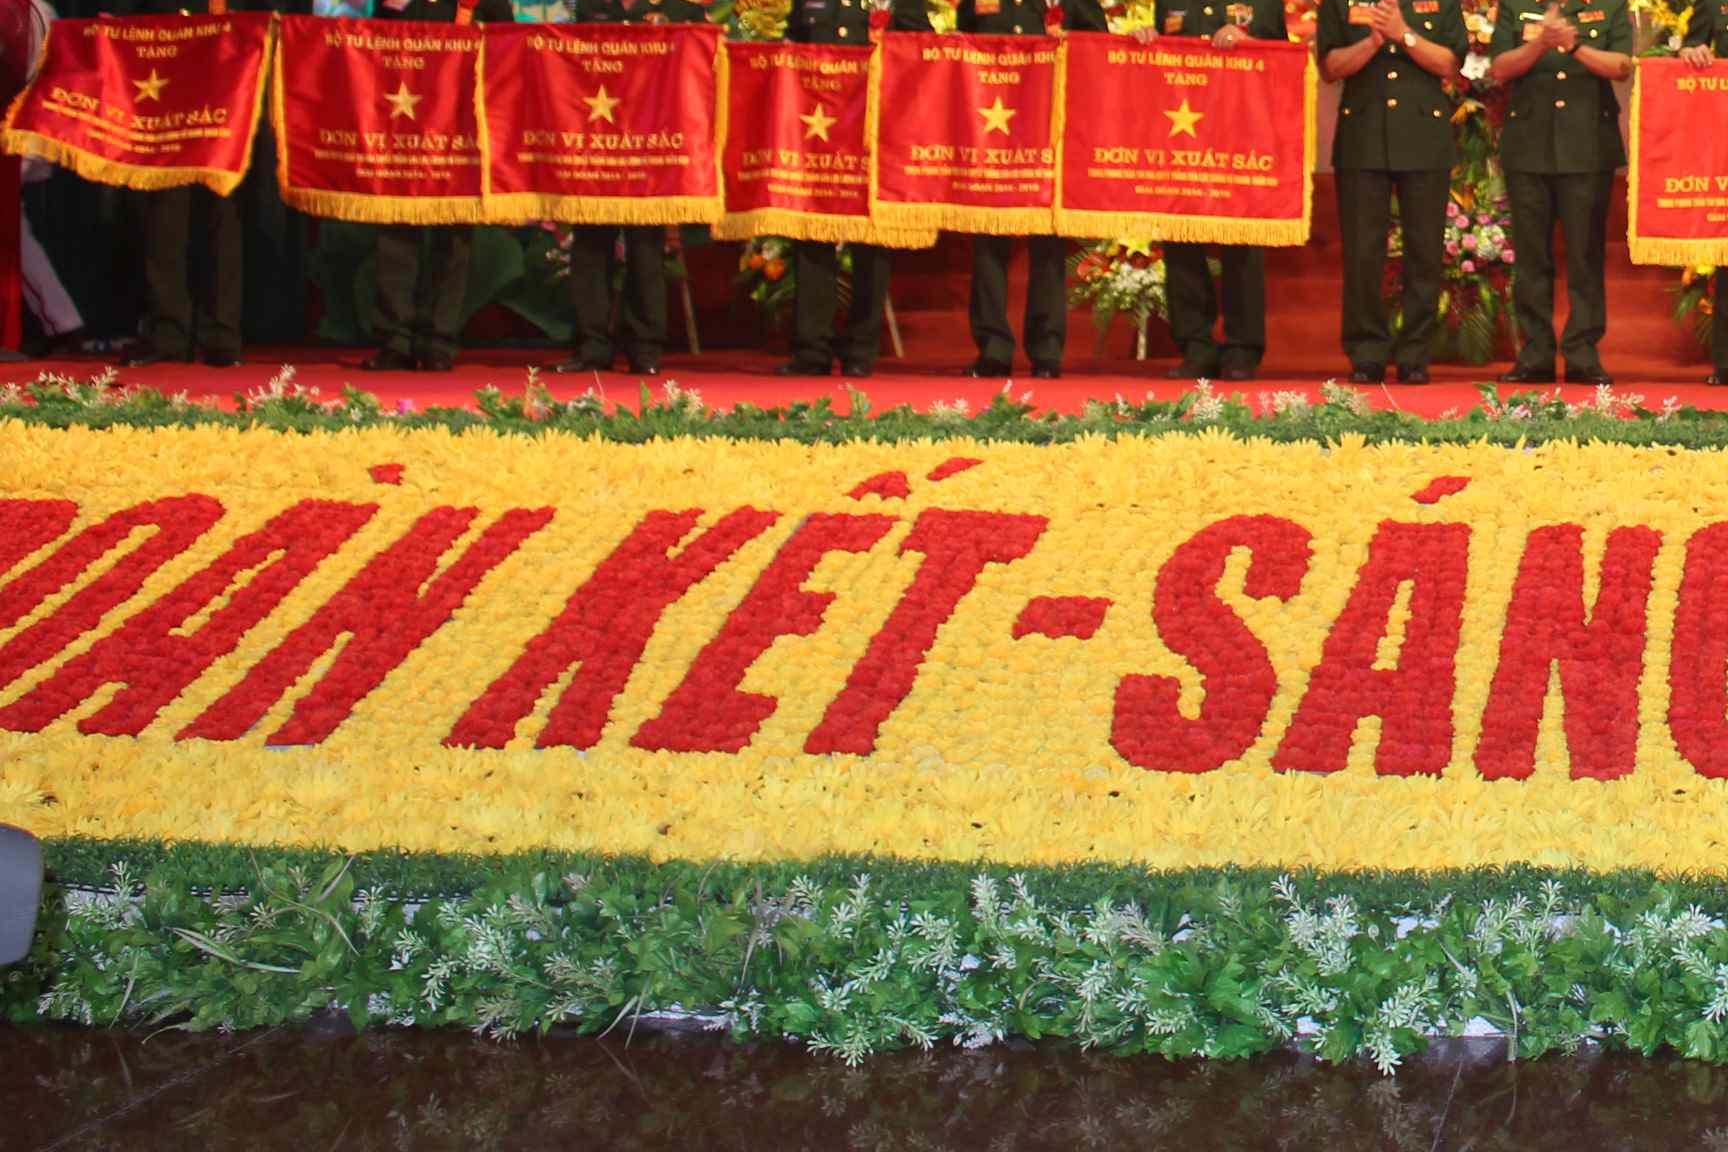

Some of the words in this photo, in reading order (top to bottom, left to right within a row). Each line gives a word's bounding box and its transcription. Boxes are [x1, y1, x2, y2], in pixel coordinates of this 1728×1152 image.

[1185, 52, 1222, 69] QUÂN
[1678, 77, 1696, 93] BỘ
[1700, 77, 1716, 91] TƯ
[1094, 147, 1138, 164] ĐƠN
[1173, 148, 1229, 168] XUẤT
[1665, 176, 1709, 193] ĐƠN
[440, 457, 1049, 756] KẾT
